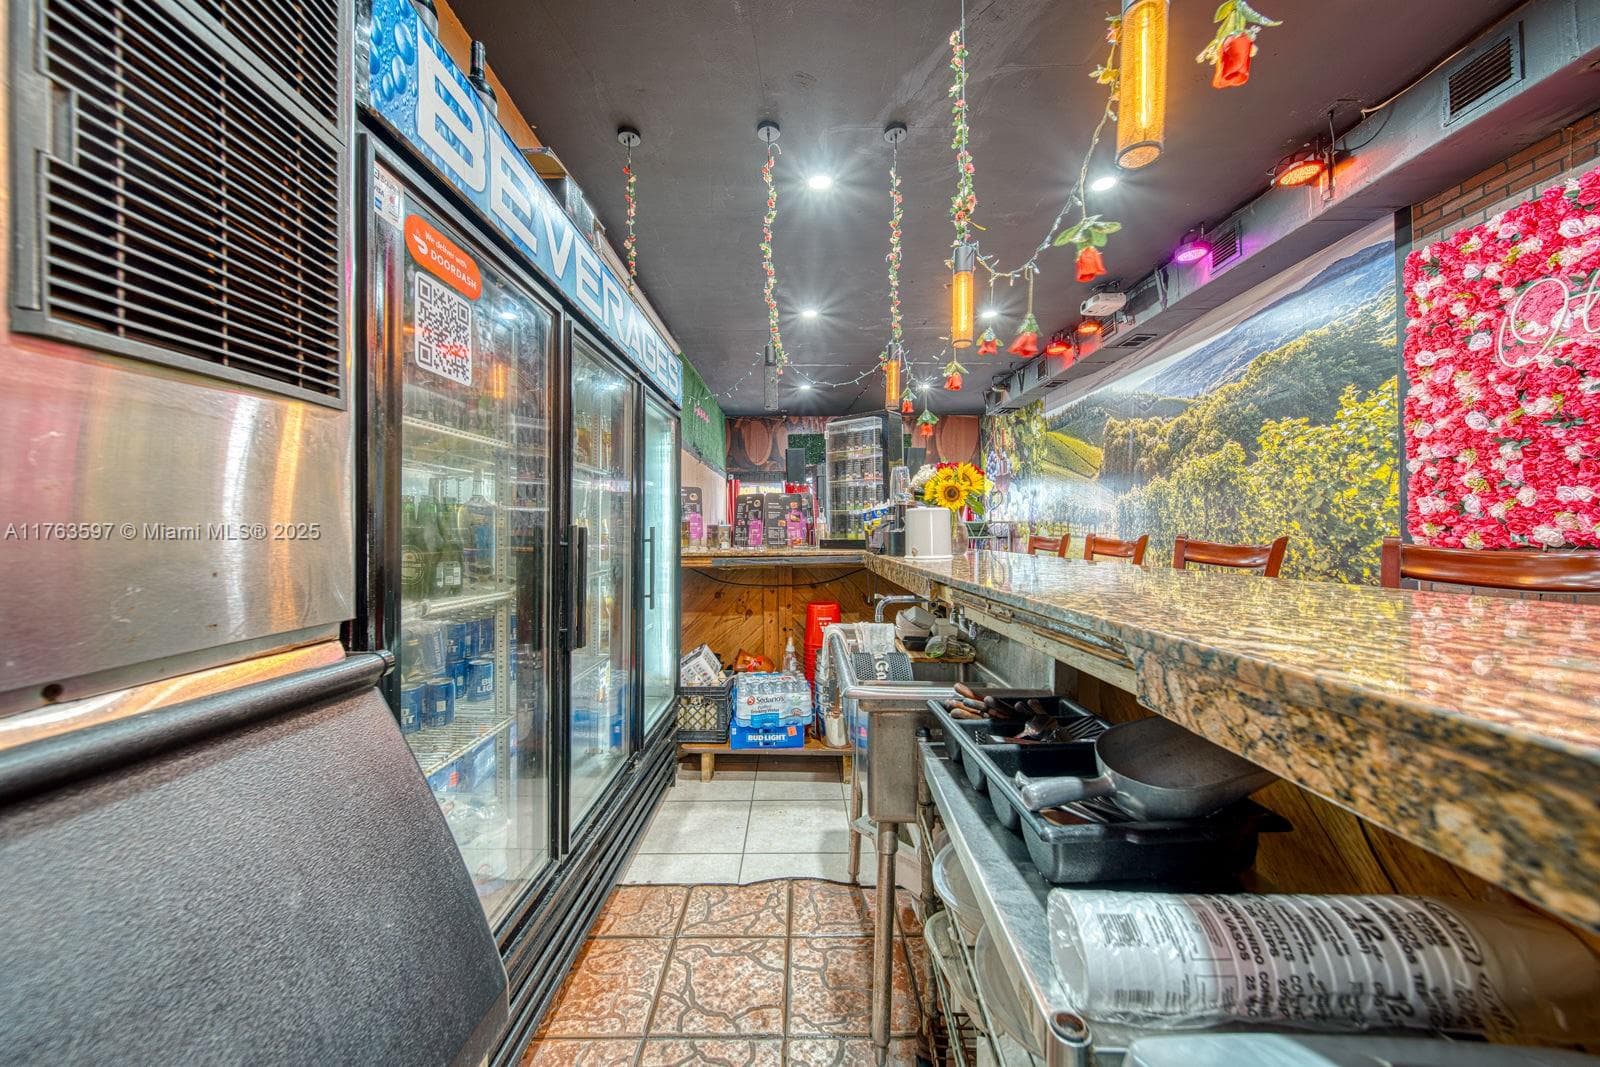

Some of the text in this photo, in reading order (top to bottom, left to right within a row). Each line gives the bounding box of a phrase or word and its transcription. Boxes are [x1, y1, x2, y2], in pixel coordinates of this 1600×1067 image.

[417, 16, 679, 397] BEVERAGES
[431, 249, 477, 290] DOORDASH
[1222, 899, 1265, 965] CONTENIDO
[1223, 917, 1251, 961] VASOS
[1253, 901, 1296, 962] CONTENTS
[1255, 920, 1280, 957] CUPS
[1352, 913, 1385, 942] 12
[1406, 911, 1438, 946] CUPS
